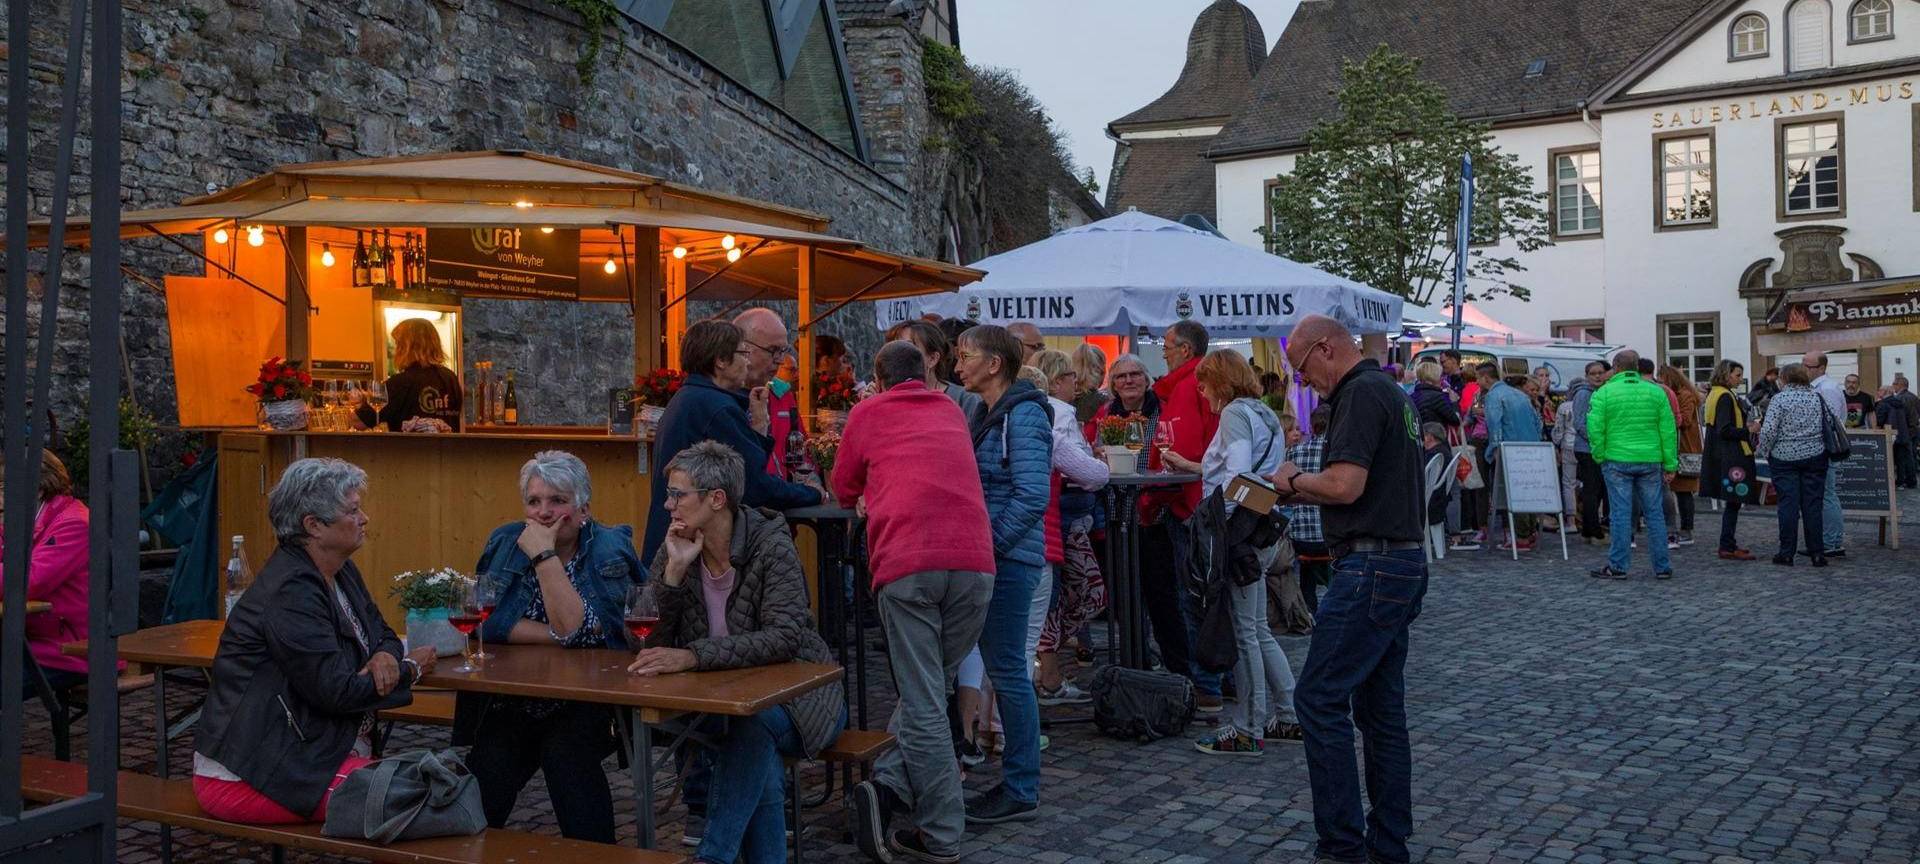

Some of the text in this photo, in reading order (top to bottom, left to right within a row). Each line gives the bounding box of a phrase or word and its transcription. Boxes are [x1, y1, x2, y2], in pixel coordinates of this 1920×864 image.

[1653, 82, 1913, 128] SAUERLAND-MUS
[497, 253, 545, 268] von Weyher
[988, 296, 1075, 319] VELTINS
[1200, 293, 1295, 317] VELTINS
